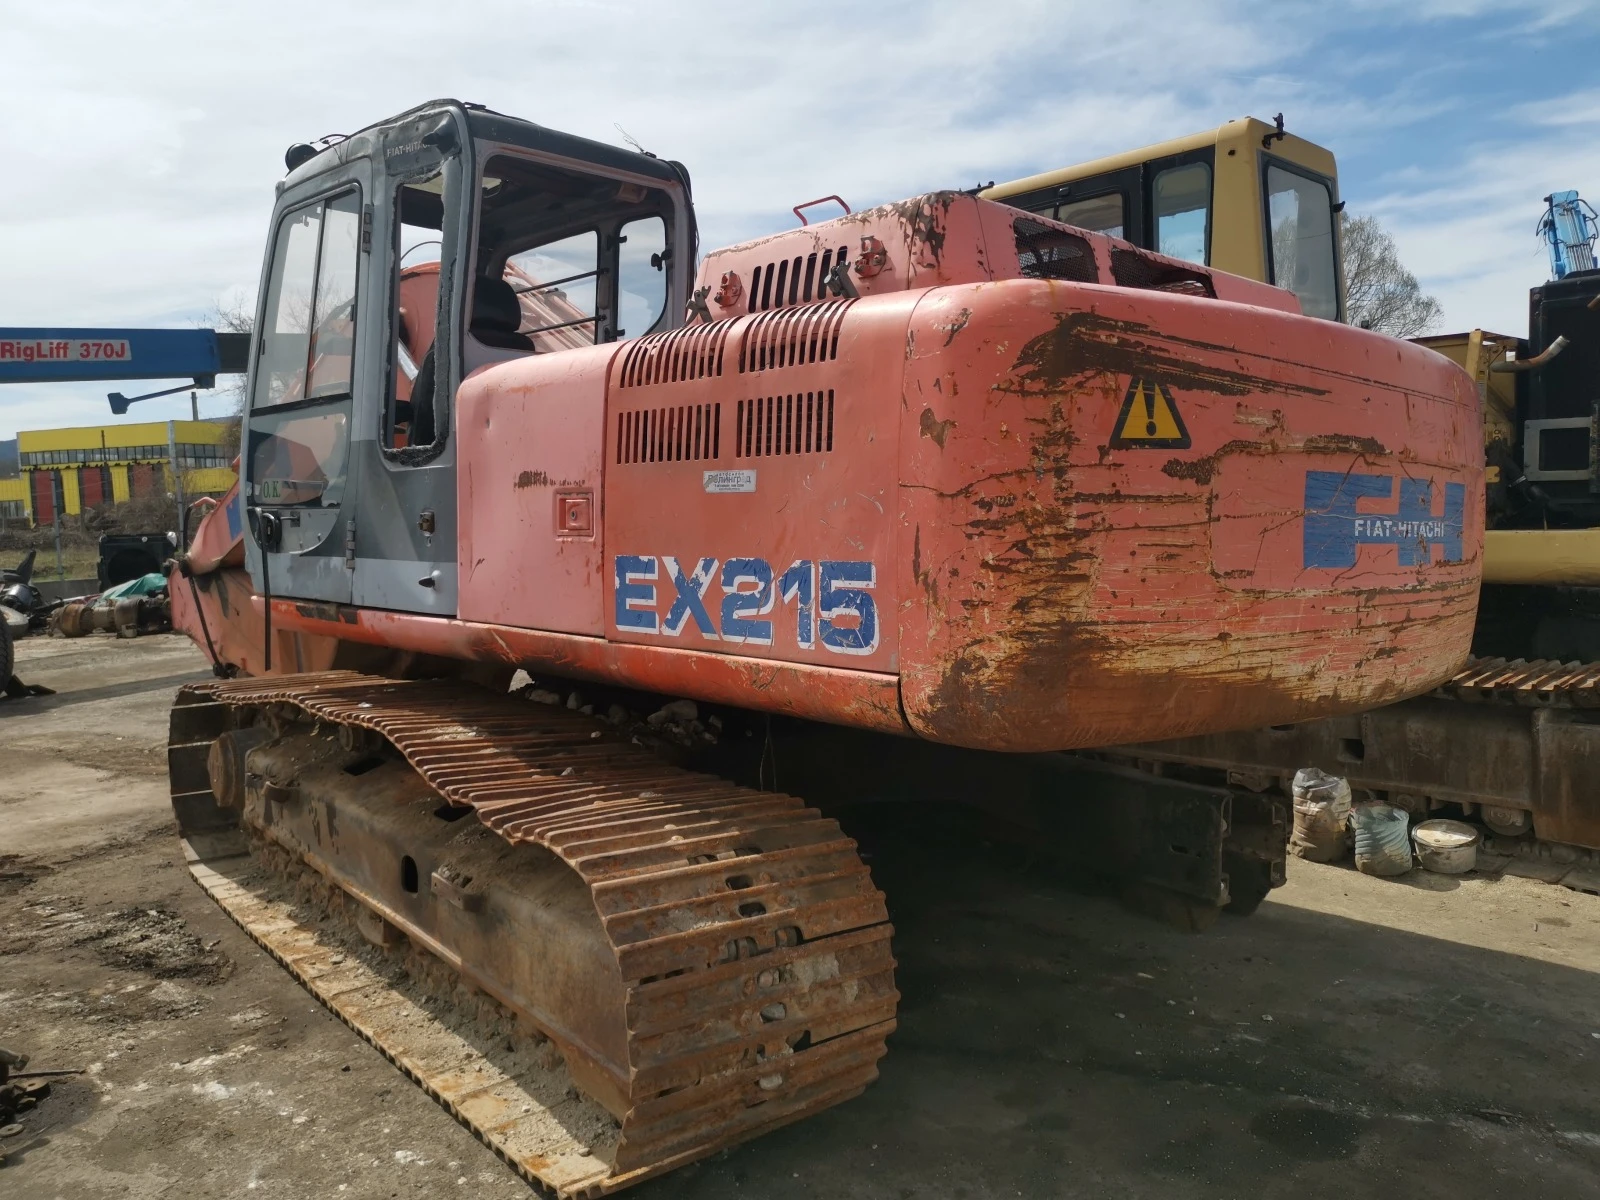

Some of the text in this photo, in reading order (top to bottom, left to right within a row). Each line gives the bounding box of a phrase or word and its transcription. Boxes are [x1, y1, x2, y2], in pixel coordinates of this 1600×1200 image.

[79, 343, 125, 358] 370J
[1354, 519, 1445, 538] FIAT-HITACHI
[615, 555, 880, 656] EX215
